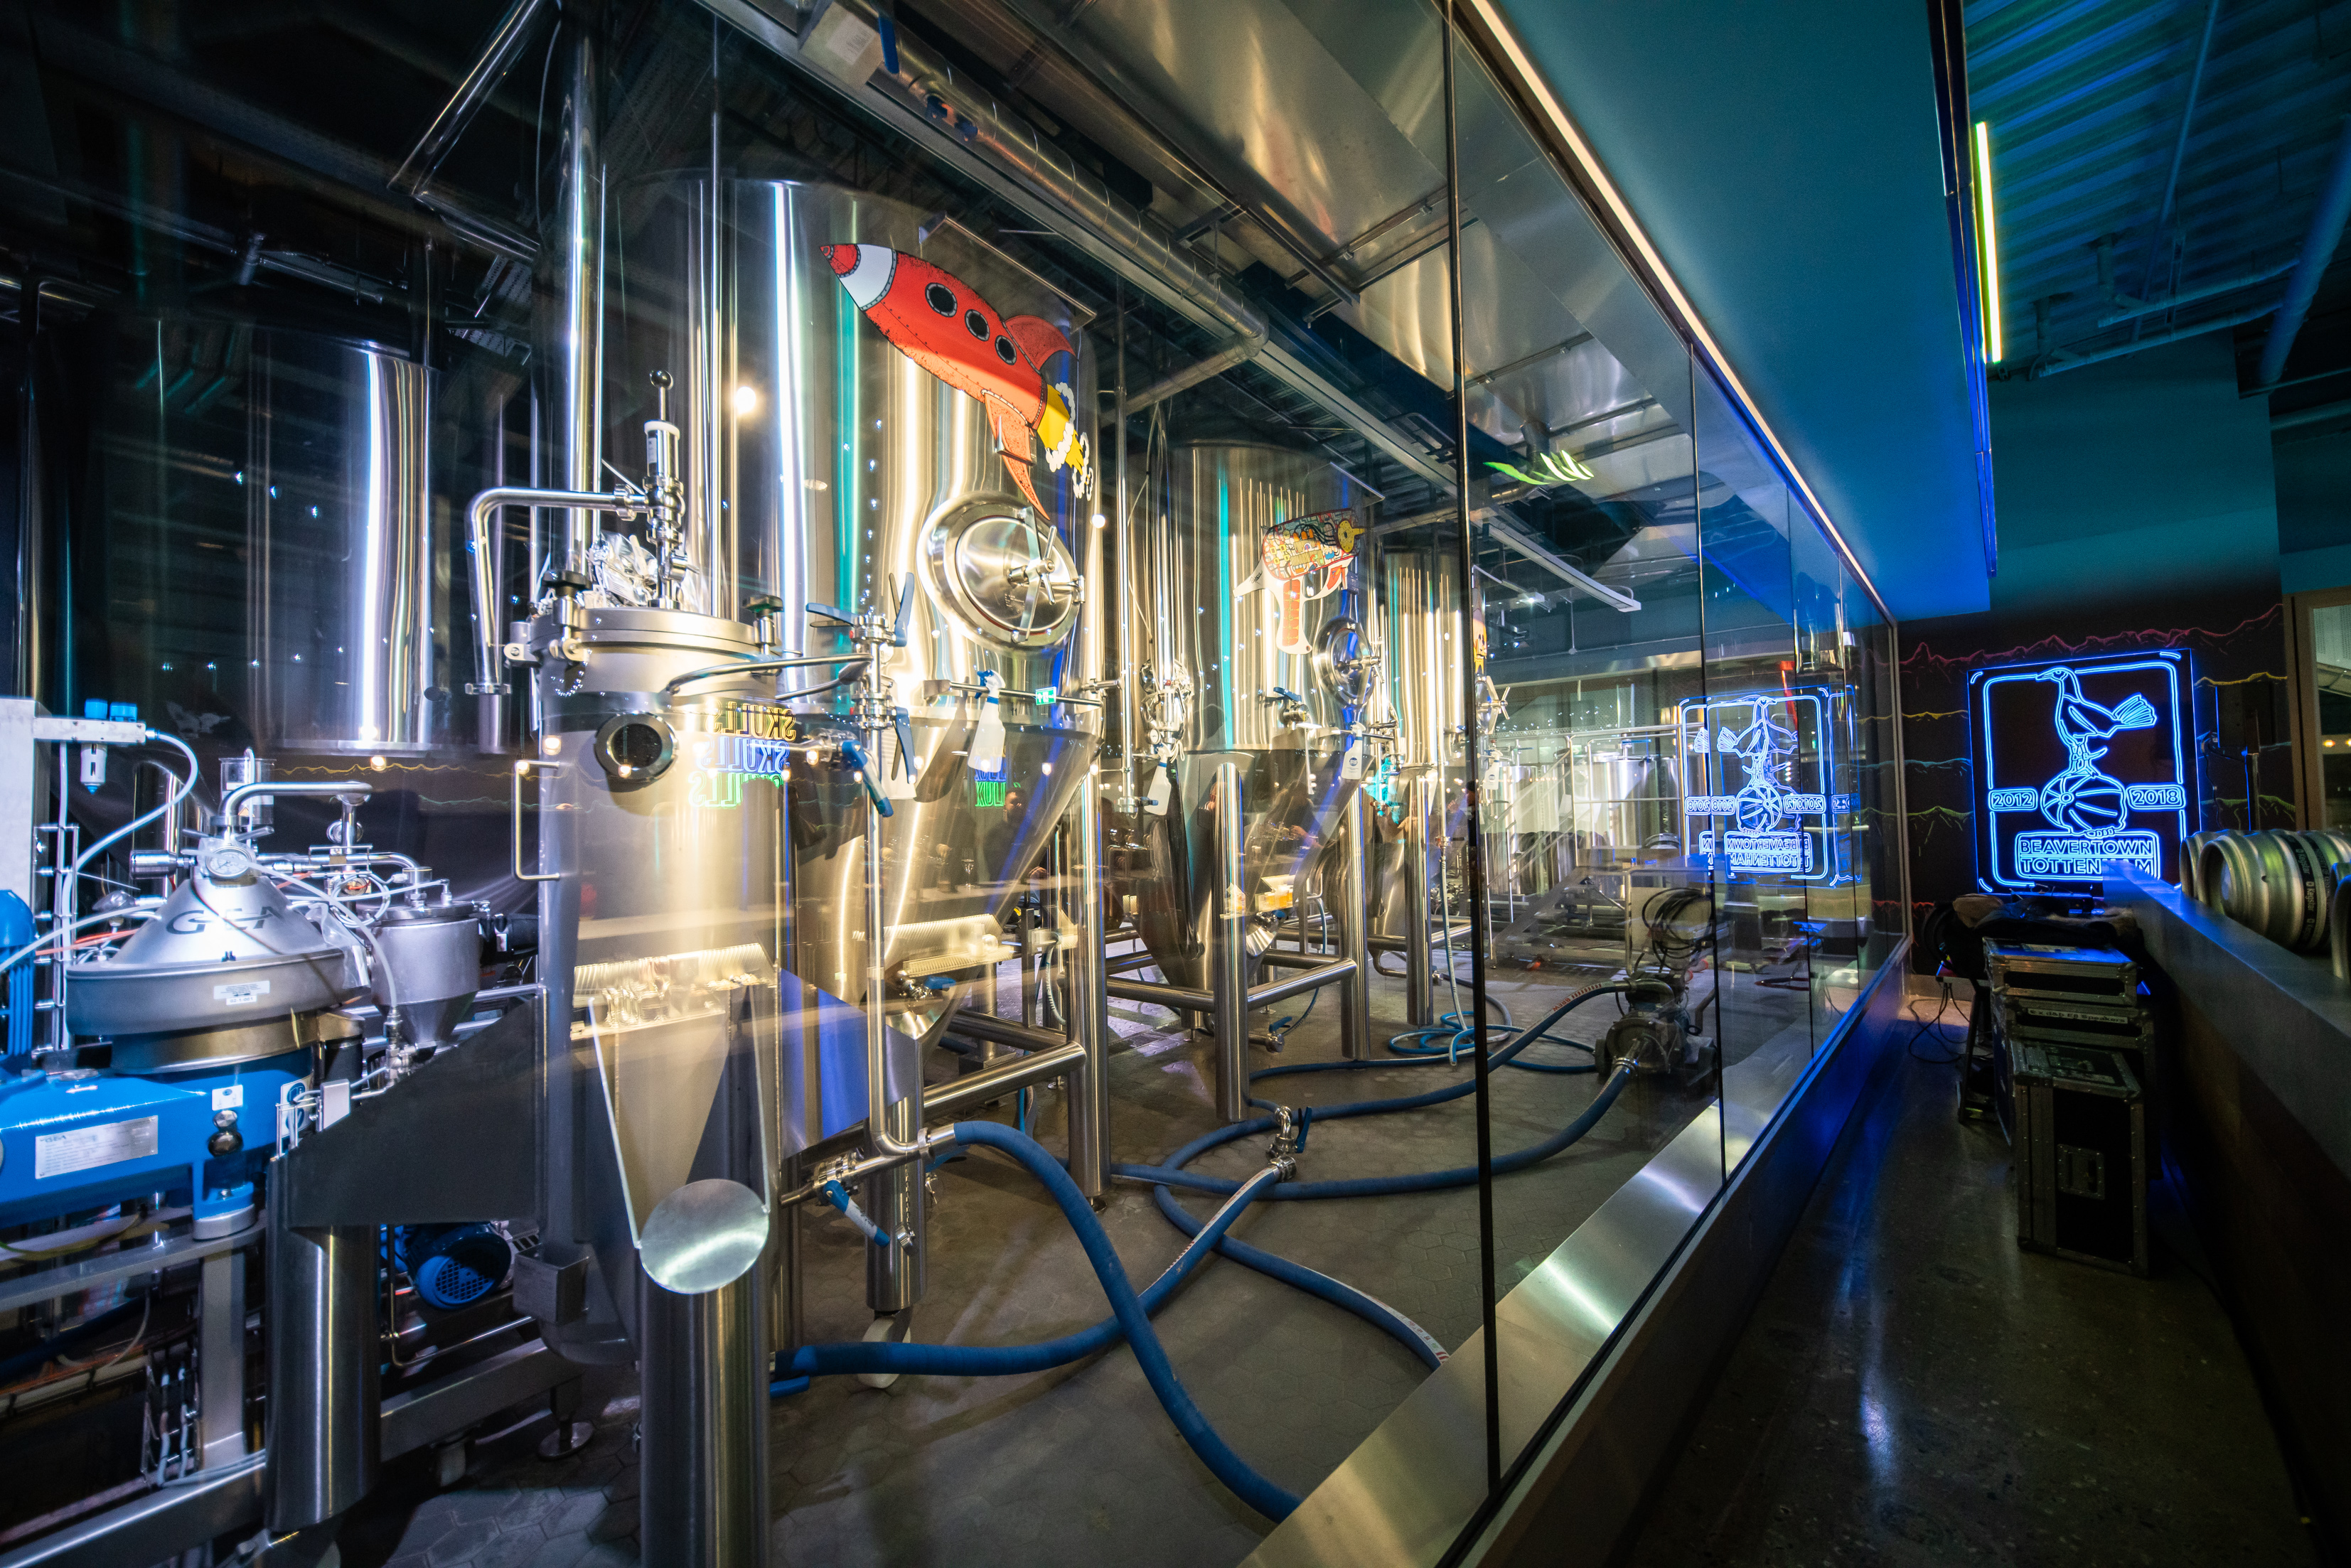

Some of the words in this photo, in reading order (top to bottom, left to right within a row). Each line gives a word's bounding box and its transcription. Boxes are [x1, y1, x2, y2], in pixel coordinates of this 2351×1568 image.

[1993, 792, 2033, 807] 2012
[2132, 789, 2180, 805] 2018
[2020, 840, 2153, 855] BEAVERTOWN
[2020, 858, 2153, 876] TOTTENM
[2298, 854, 2310, 874] Kegstar
[2305, 888, 2315, 912] Kegstar
[166, 906, 282, 935] GEA
[1553, 997, 1571, 1012] BREW
[2082, 1014, 2125, 1023] Speakers
